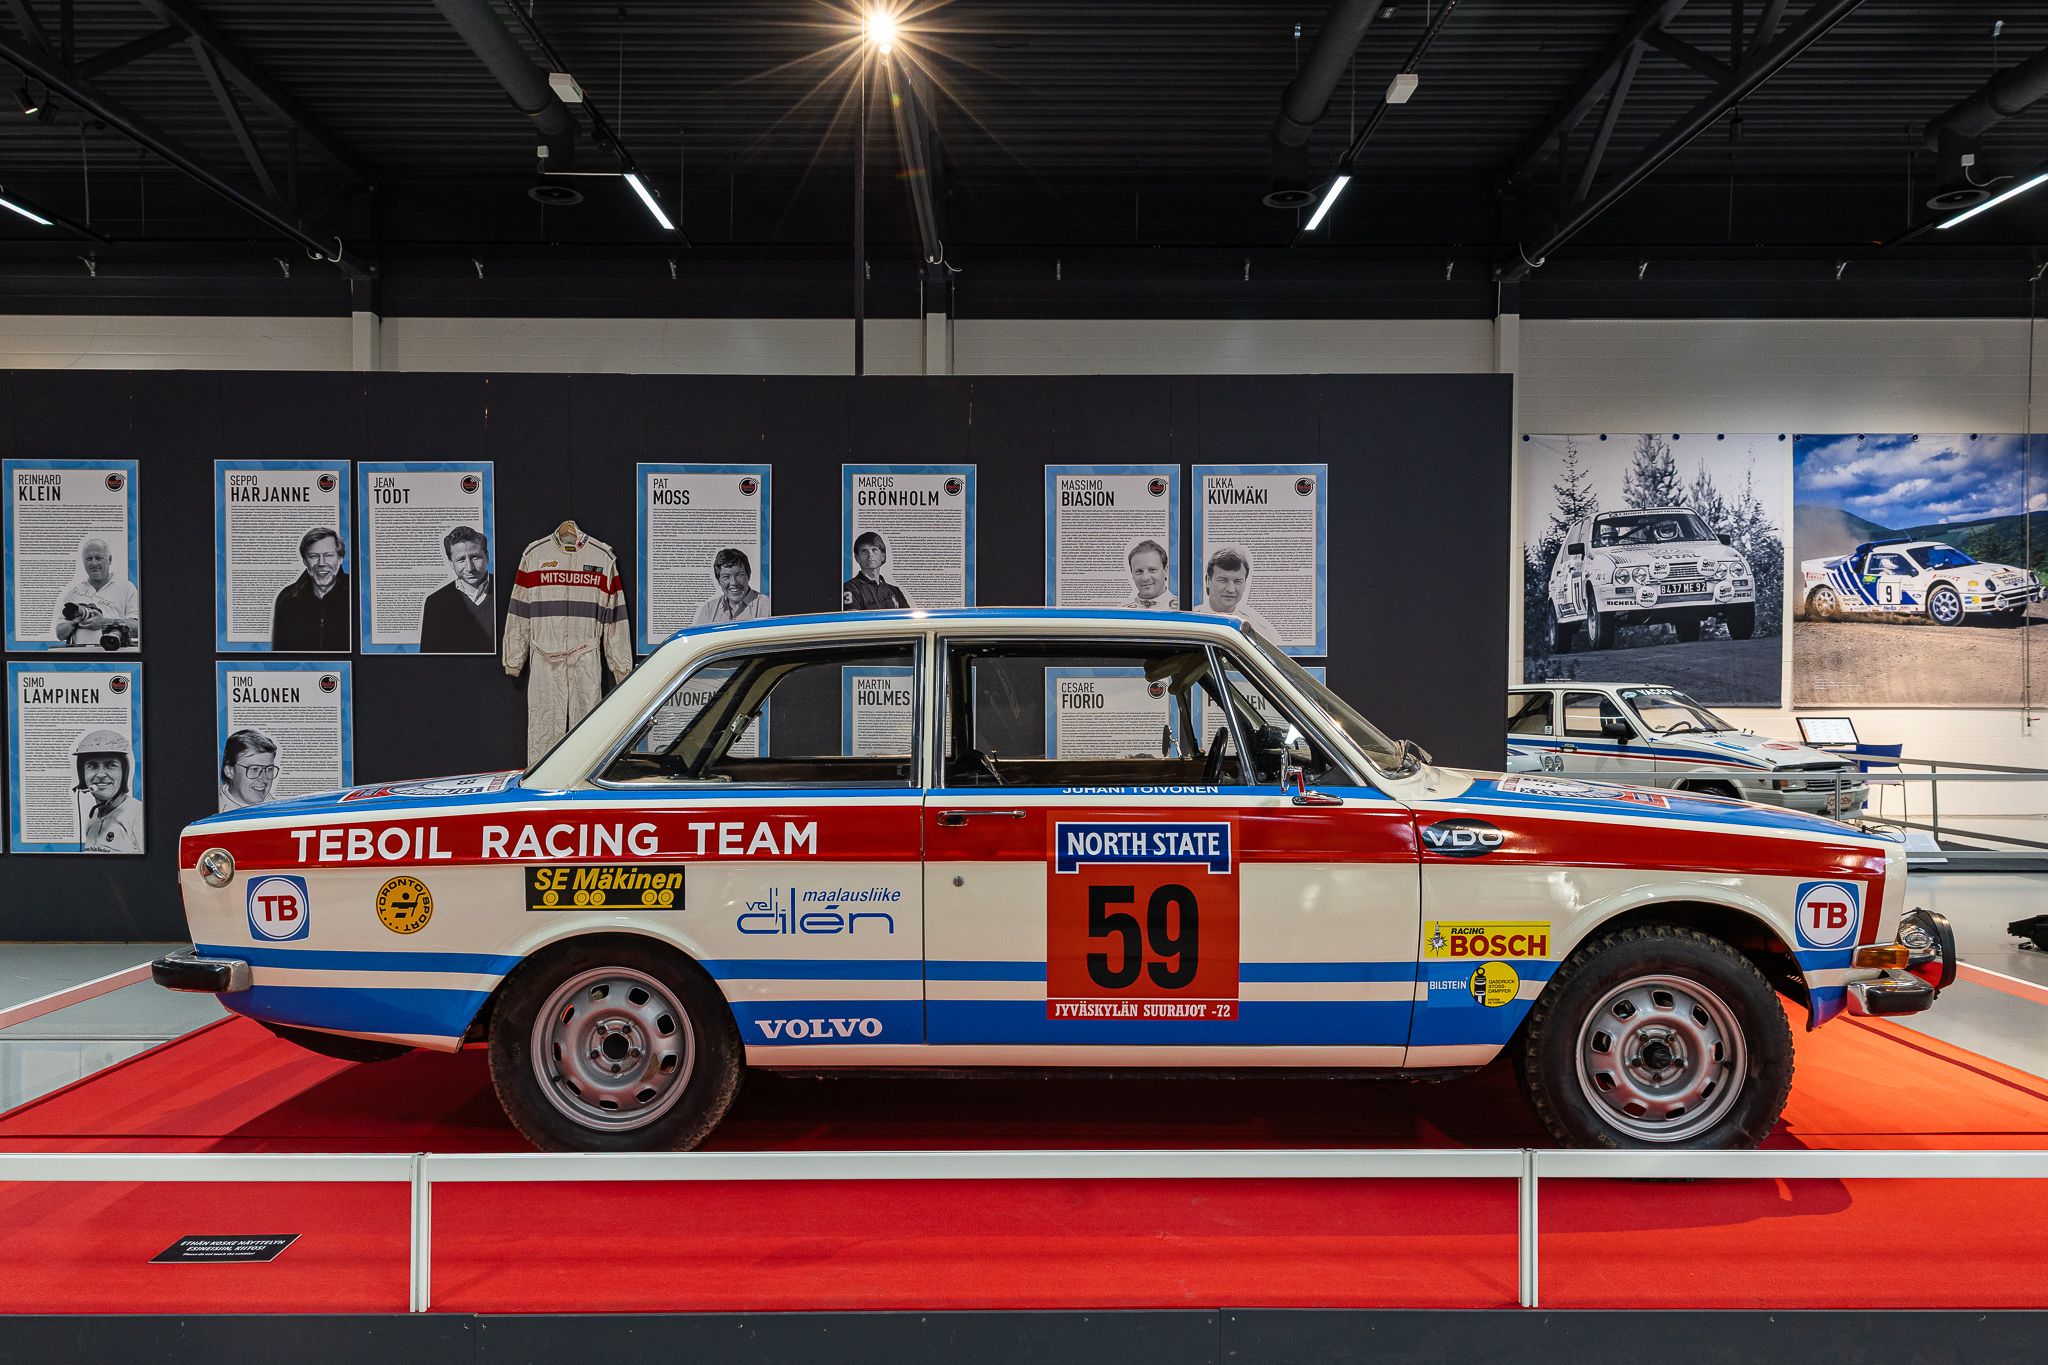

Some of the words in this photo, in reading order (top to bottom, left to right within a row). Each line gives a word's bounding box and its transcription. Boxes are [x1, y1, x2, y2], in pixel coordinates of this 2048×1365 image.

[18, 474, 62, 486] REINHARD
[230, 474, 258, 486] SEPPO
[373, 477, 396, 488] JEAN
[653, 478, 669, 489] PAT
[858, 476, 894, 488] MARCUS
[1061, 480, 1103, 491] MASSIMO
[1207, 478, 1234, 488] ILKKA
[18, 486, 62, 502] KLEIN
[230, 486, 311, 503] HARJANNE
[374, 489, 411, 504] TODT
[653, 490, 690, 505] MOSS
[858, 487, 940, 506] GRÖNHOLM
[1061, 491, 1115, 507] BIASION
[1208, 486, 1268, 505] KIVIMÄKI
[540, 572, 601, 586] MITSUBISHI
[1661, 584, 1682, 594] 8437
[1696, 582, 1707, 592] 92
[1885, 585, 1892, 603] 9
[843, 591, 853, 605] 3
[23, 677, 45, 688] SIMO
[232, 676, 254, 687] TIMO
[857, 679, 892, 690] MARTIN
[1061, 682, 1095, 693] CESARE
[23, 688, 99, 704] LAMPINEN
[232, 687, 300, 704] SALONEN
[857, 690, 911, 706] HOLMES
[1061, 693, 1104, 709] FIORIO
[1062, 786, 1125, 794] JUHANI
[1132, 786, 1219, 794] TOIVONEN
[290, 827, 452, 863] TEBOIL
[481, 822, 659, 860] RACING
[688, 821, 818, 856] TEAM
[1067, 832, 1147, 856] NORTH
[1152, 832, 1221, 856] STATE
[1426, 829, 1503, 847] VDO
[534, 869, 569, 891] SE
[573, 866, 683, 891] Mäkinen
[379, 879, 424, 915] TORONTO
[802, 887, 901, 903] maalausliike
[258, 895, 298, 922] TB
[404, 896, 430, 932] SPORT
[1807, 902, 1848, 929] TB
[1086, 883, 1199, 990] 59
[1451, 927, 1485, 935] RACING
[1451, 935, 1547, 957] BOSCH
[1429, 980, 1467, 990] BILSTEIN
[1055, 1000, 1138, 1018] JYVÄSKYLÄN
[1143, 1004, 1207, 1017] SUURAJOT
[1211, 1004, 1231, 1017] -72
[754, 1017, 884, 1039] VOLVO
